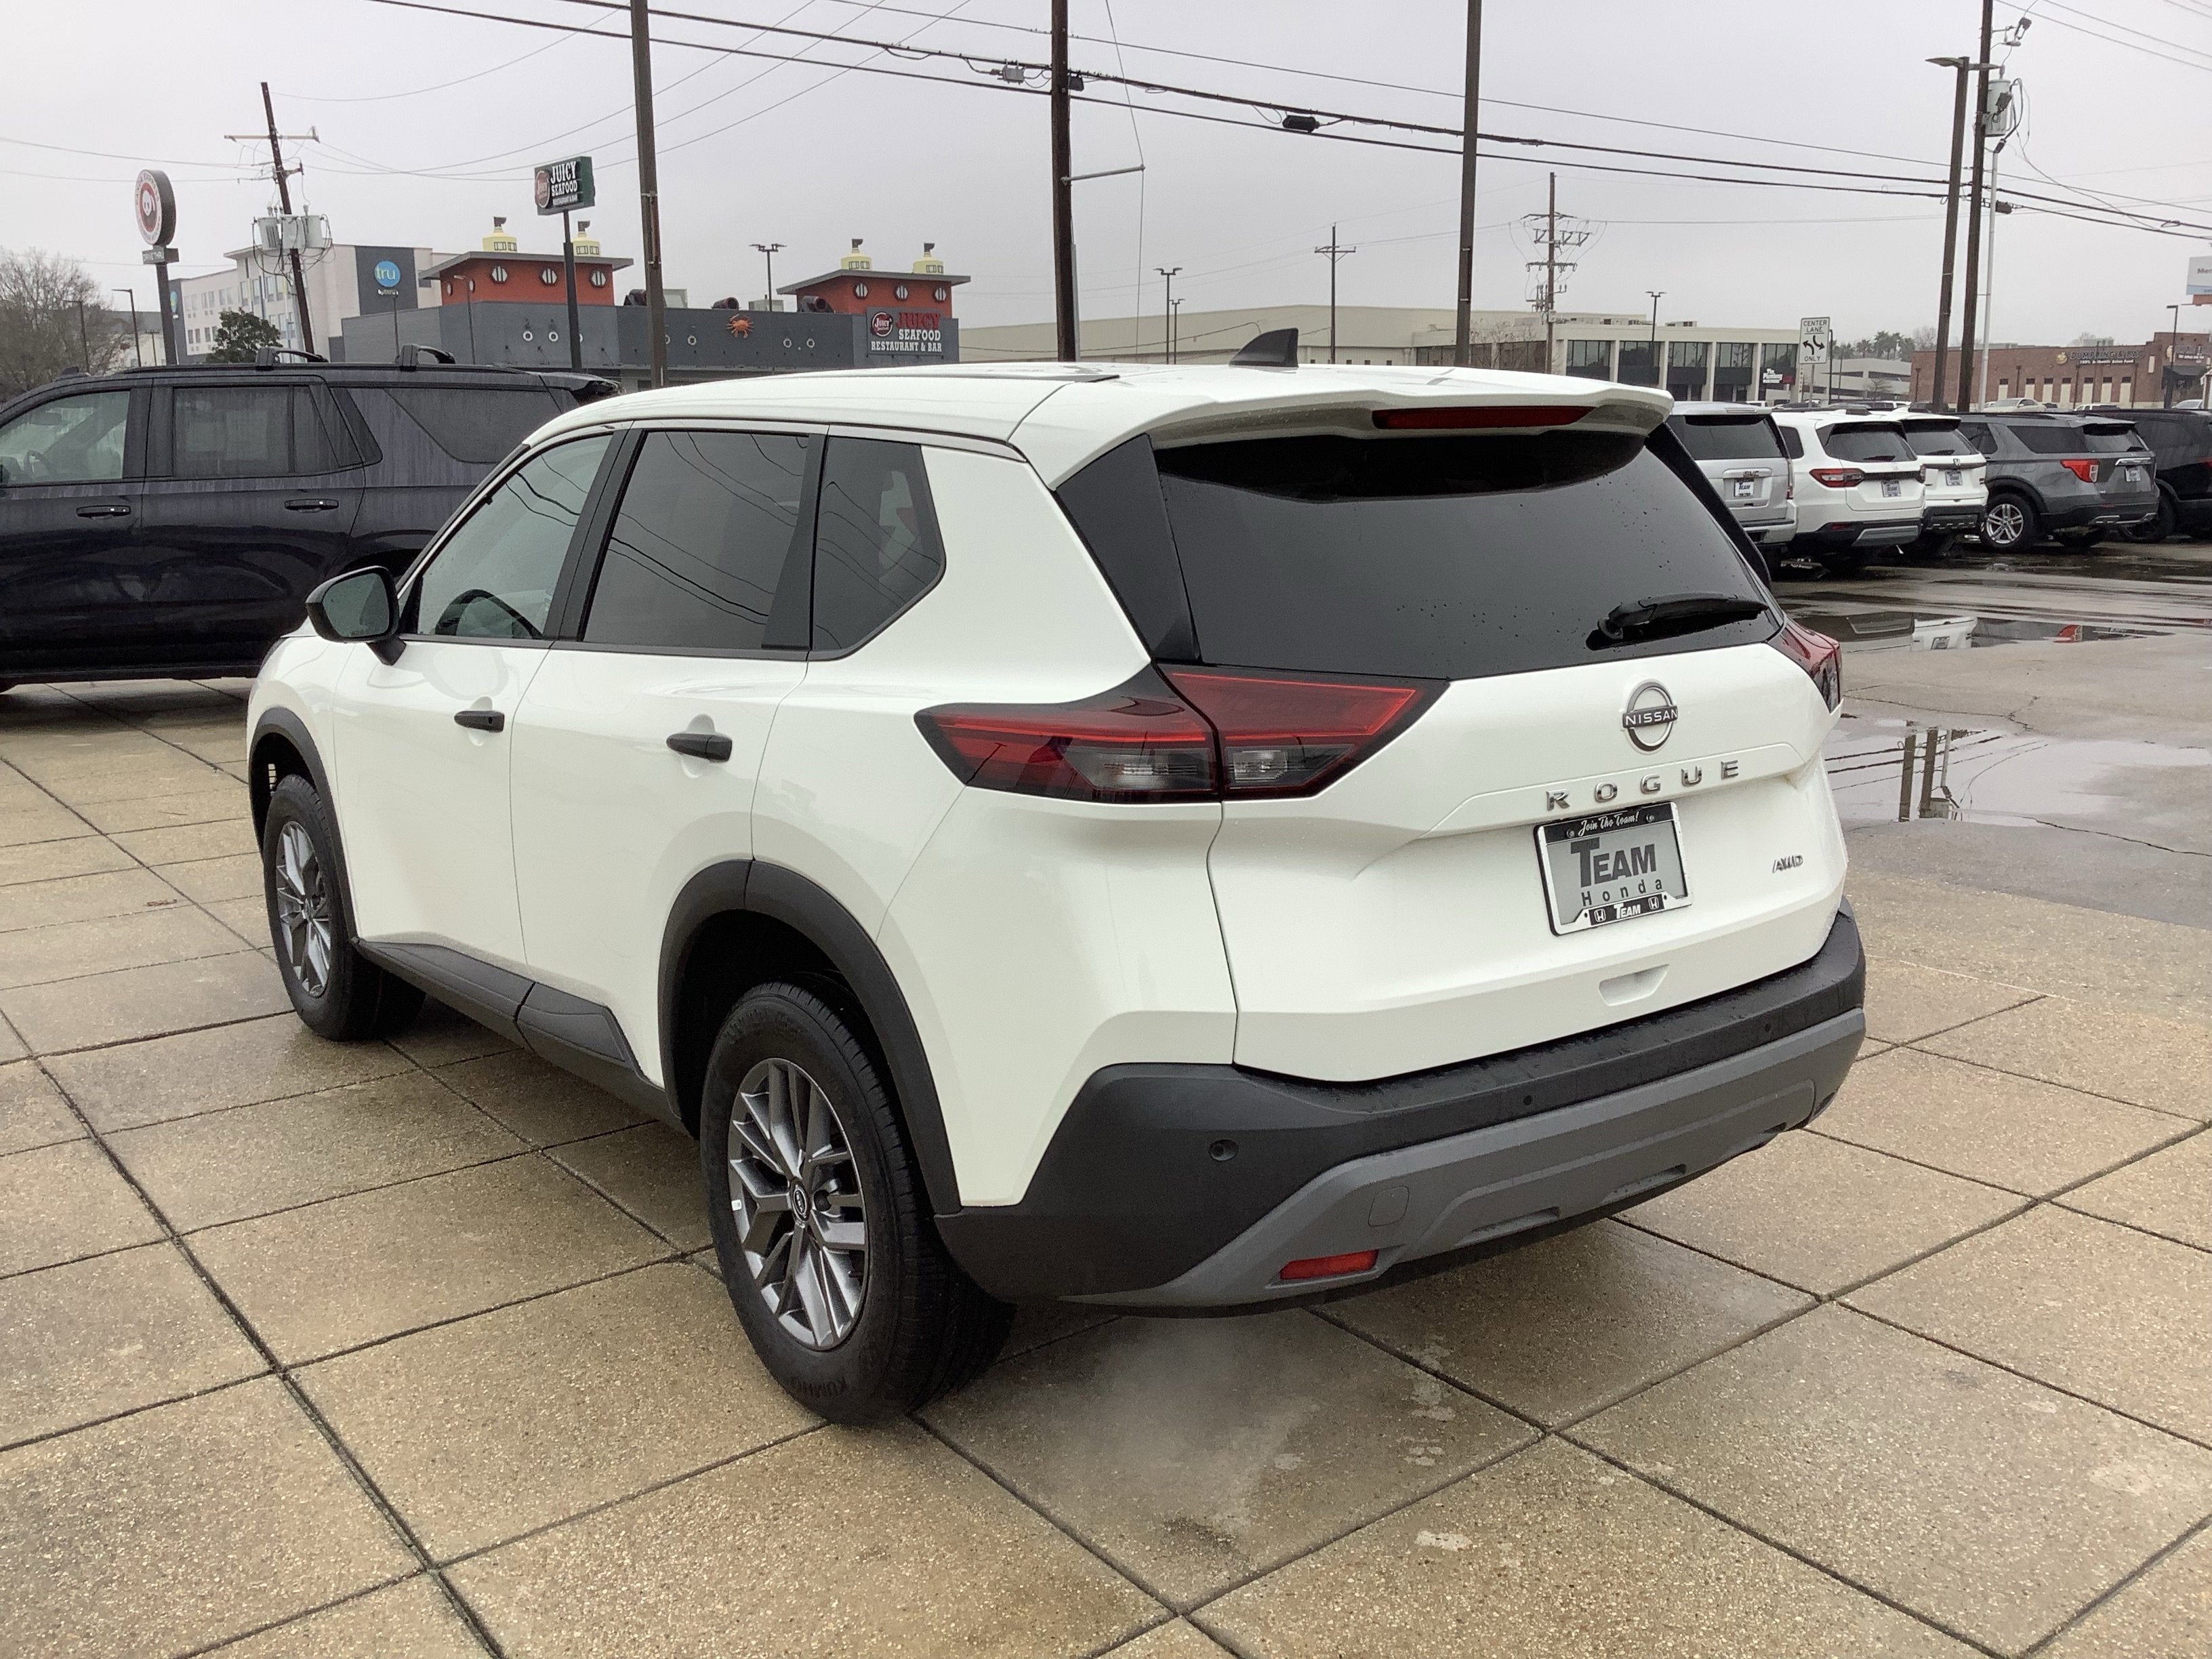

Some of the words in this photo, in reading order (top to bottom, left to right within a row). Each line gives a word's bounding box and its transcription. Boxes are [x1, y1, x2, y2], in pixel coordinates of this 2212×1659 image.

[550, 161, 576, 184] JUICY
[551, 180, 578, 197] SEAFOOD
[375, 265, 396, 280] tru
[896, 312, 941, 329] JUICY
[898, 329, 941, 342] SEAFOOD
[871, 341, 919, 351] RESTAURANT
[920, 342, 926, 351] &
[927, 342, 942, 352] BAR
[1625, 708, 1677, 726] NISSAN
[1546, 760, 1739, 811] ROGUE
[1578, 819, 1598, 837] Join
[1598, 815, 1614, 830] The
[1614, 811, 1639, 826] Team!
[1570, 836, 1657, 888] TEAM
[1771, 855, 1803, 874] AWD
[1581, 879, 1662, 907] Honda
[1614, 903, 1641, 920] TEAM
